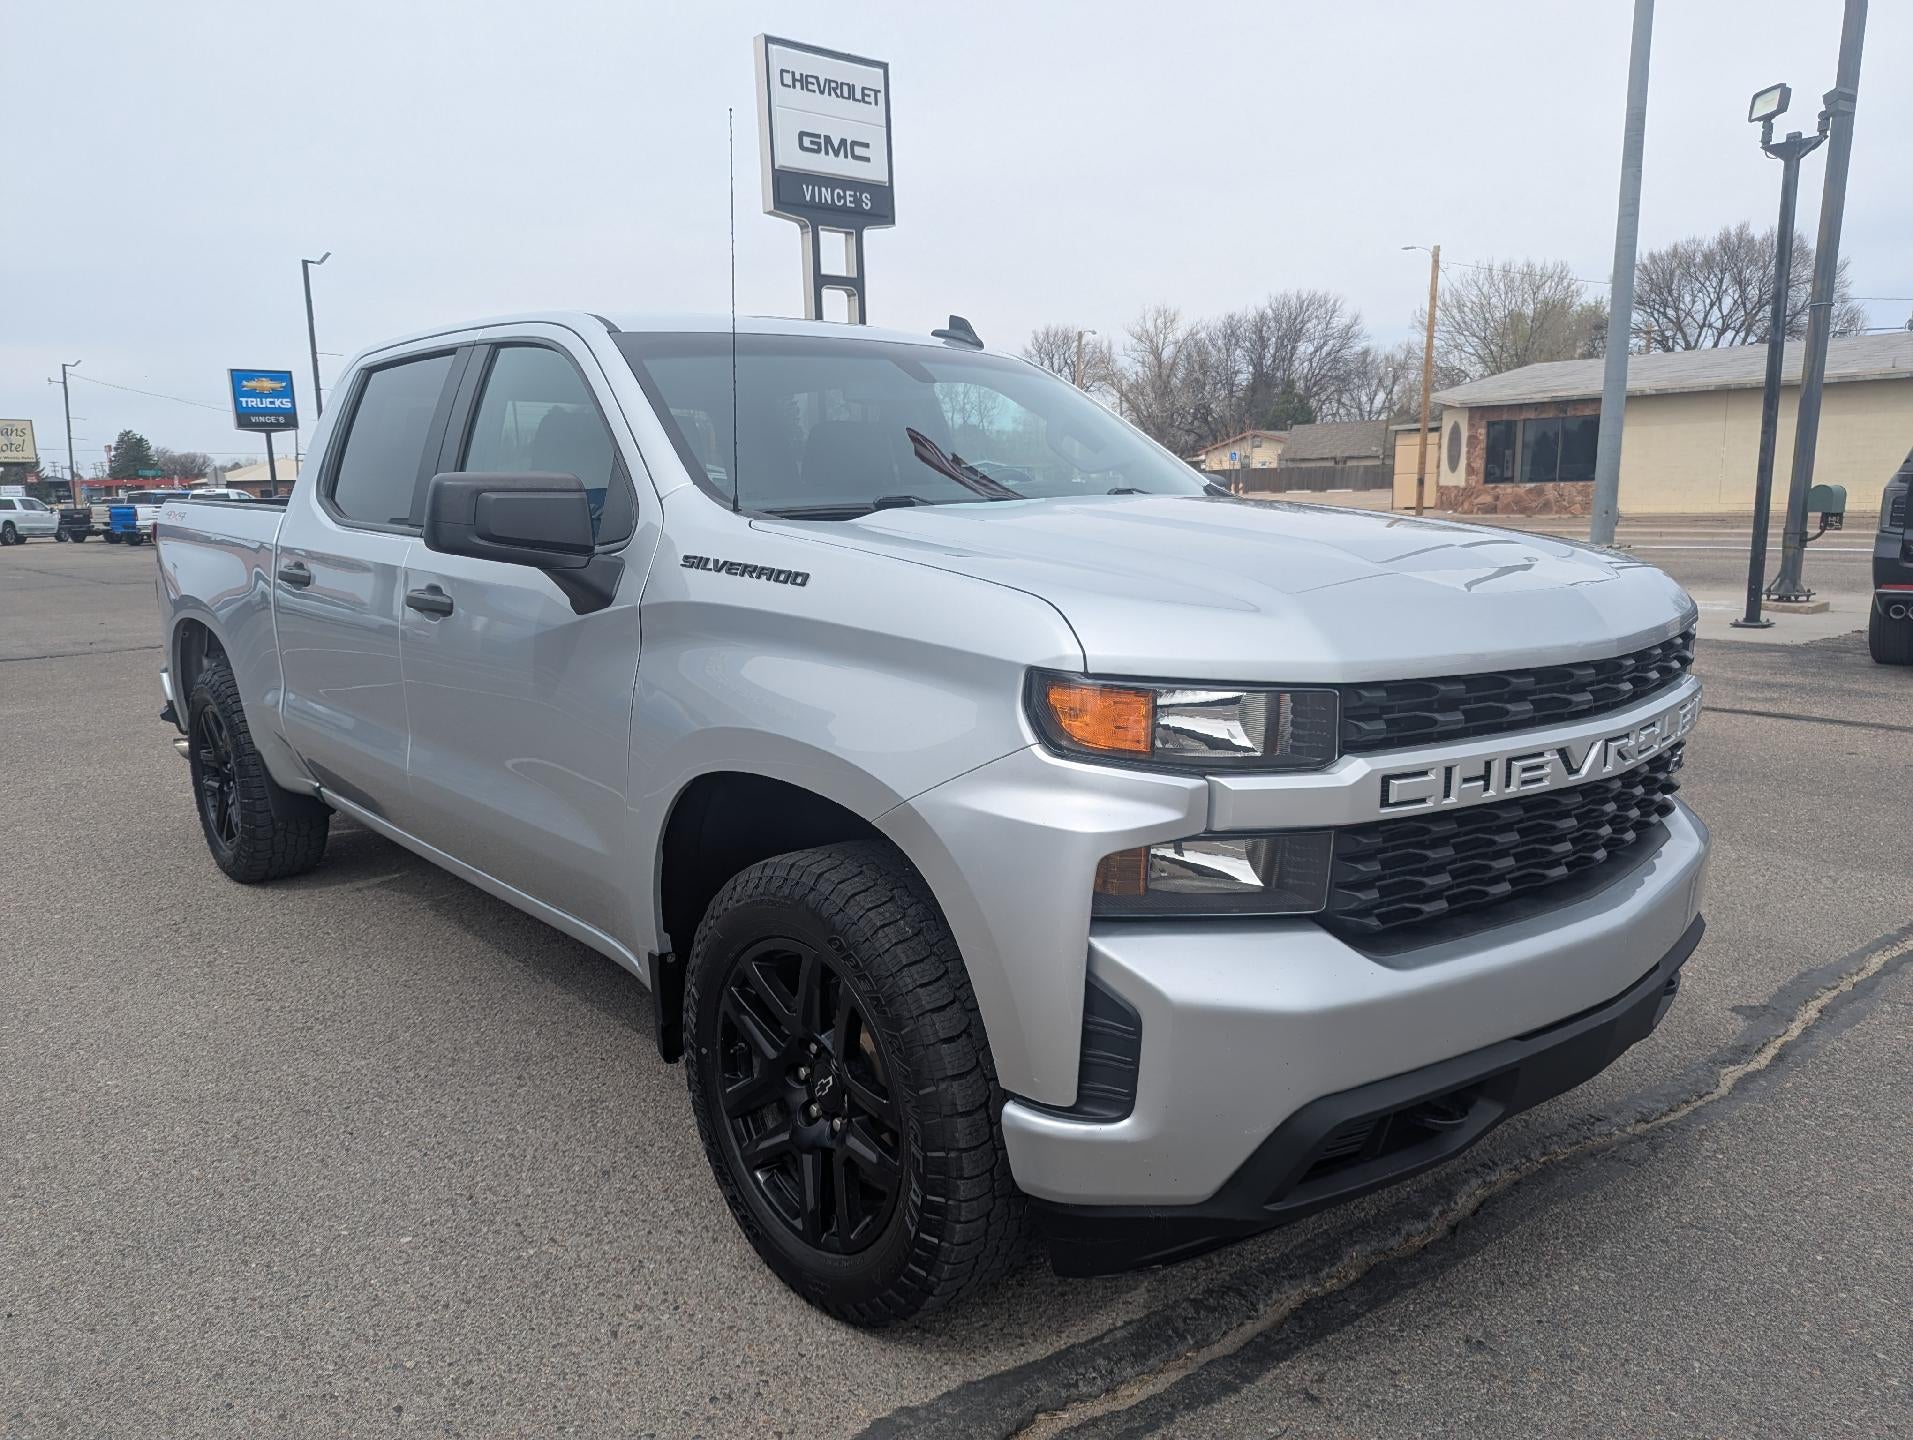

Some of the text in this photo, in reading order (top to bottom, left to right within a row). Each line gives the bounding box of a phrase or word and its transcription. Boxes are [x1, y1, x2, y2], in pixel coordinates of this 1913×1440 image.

[779, 68, 881, 106] CHEVROLET
[798, 130, 871, 163] GMC
[802, 184, 872, 210] VINCE'S
[239, 397, 292, 409] TRUCKS
[0, 427, 26, 438] ans
[250, 415, 285, 424] VINCE'S
[0, 439, 25, 453] otel
[680, 554, 810, 587] SILVERADO
[1379, 694, 1702, 814] CHEVROLET
